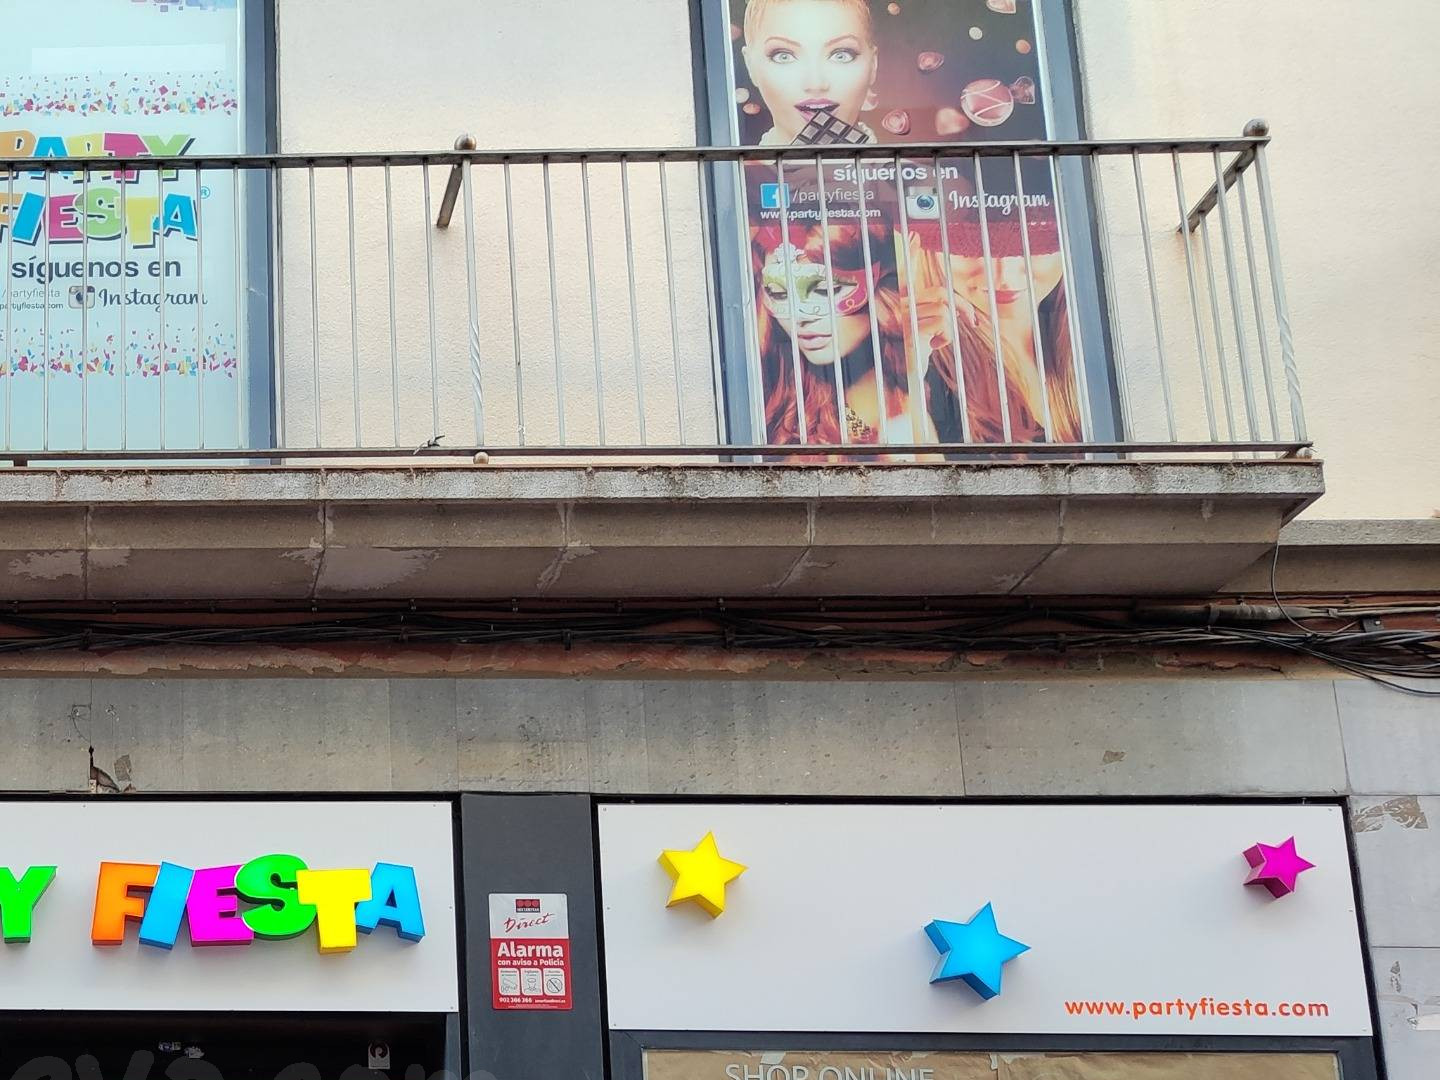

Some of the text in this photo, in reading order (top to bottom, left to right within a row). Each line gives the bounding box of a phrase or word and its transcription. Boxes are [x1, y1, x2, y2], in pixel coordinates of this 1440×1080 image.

[934, 166, 959, 179] en
[949, 190, 1050, 215] Instagram
[11, 256, 181, 285] síguenos en
[98, 288, 208, 312] Instagram
[91, 854, 427, 953] FIESTA
[497, 941, 564, 957] Alarma
[512, 958, 532, 966] aviso
[1064, 998, 1329, 1020] www.partyfiesta.com
